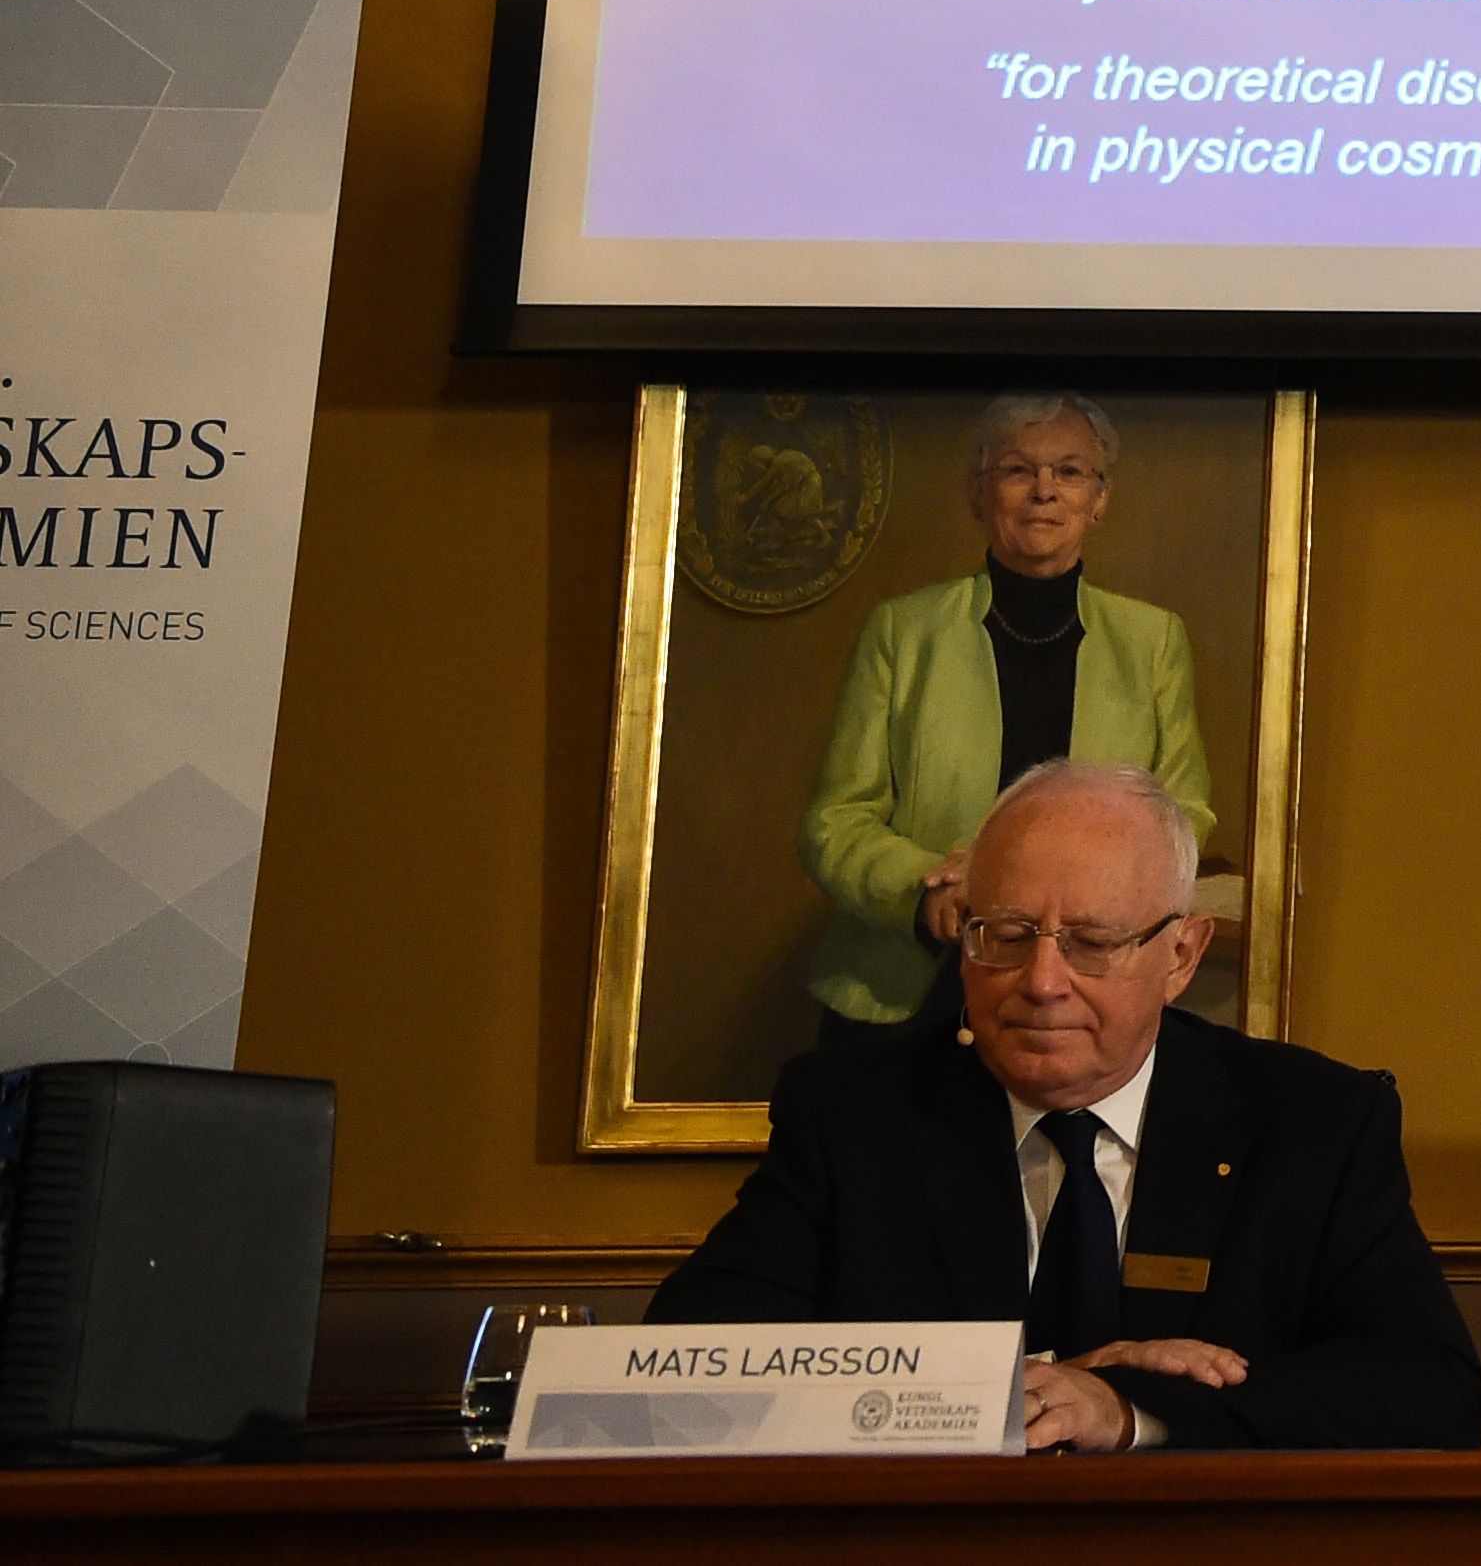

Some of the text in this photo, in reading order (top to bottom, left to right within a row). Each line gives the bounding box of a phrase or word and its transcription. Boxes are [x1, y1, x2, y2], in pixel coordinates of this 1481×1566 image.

[1092, 53, 1385, 105] theoretical
[1026, 123, 1077, 172] in
[1088, 124, 1325, 185] physical
[0, 506, 225, 569] MIEN
[25, 610, 206, 641] SCIENCES
[625, 1345, 921, 1378] MATS LARSSON
